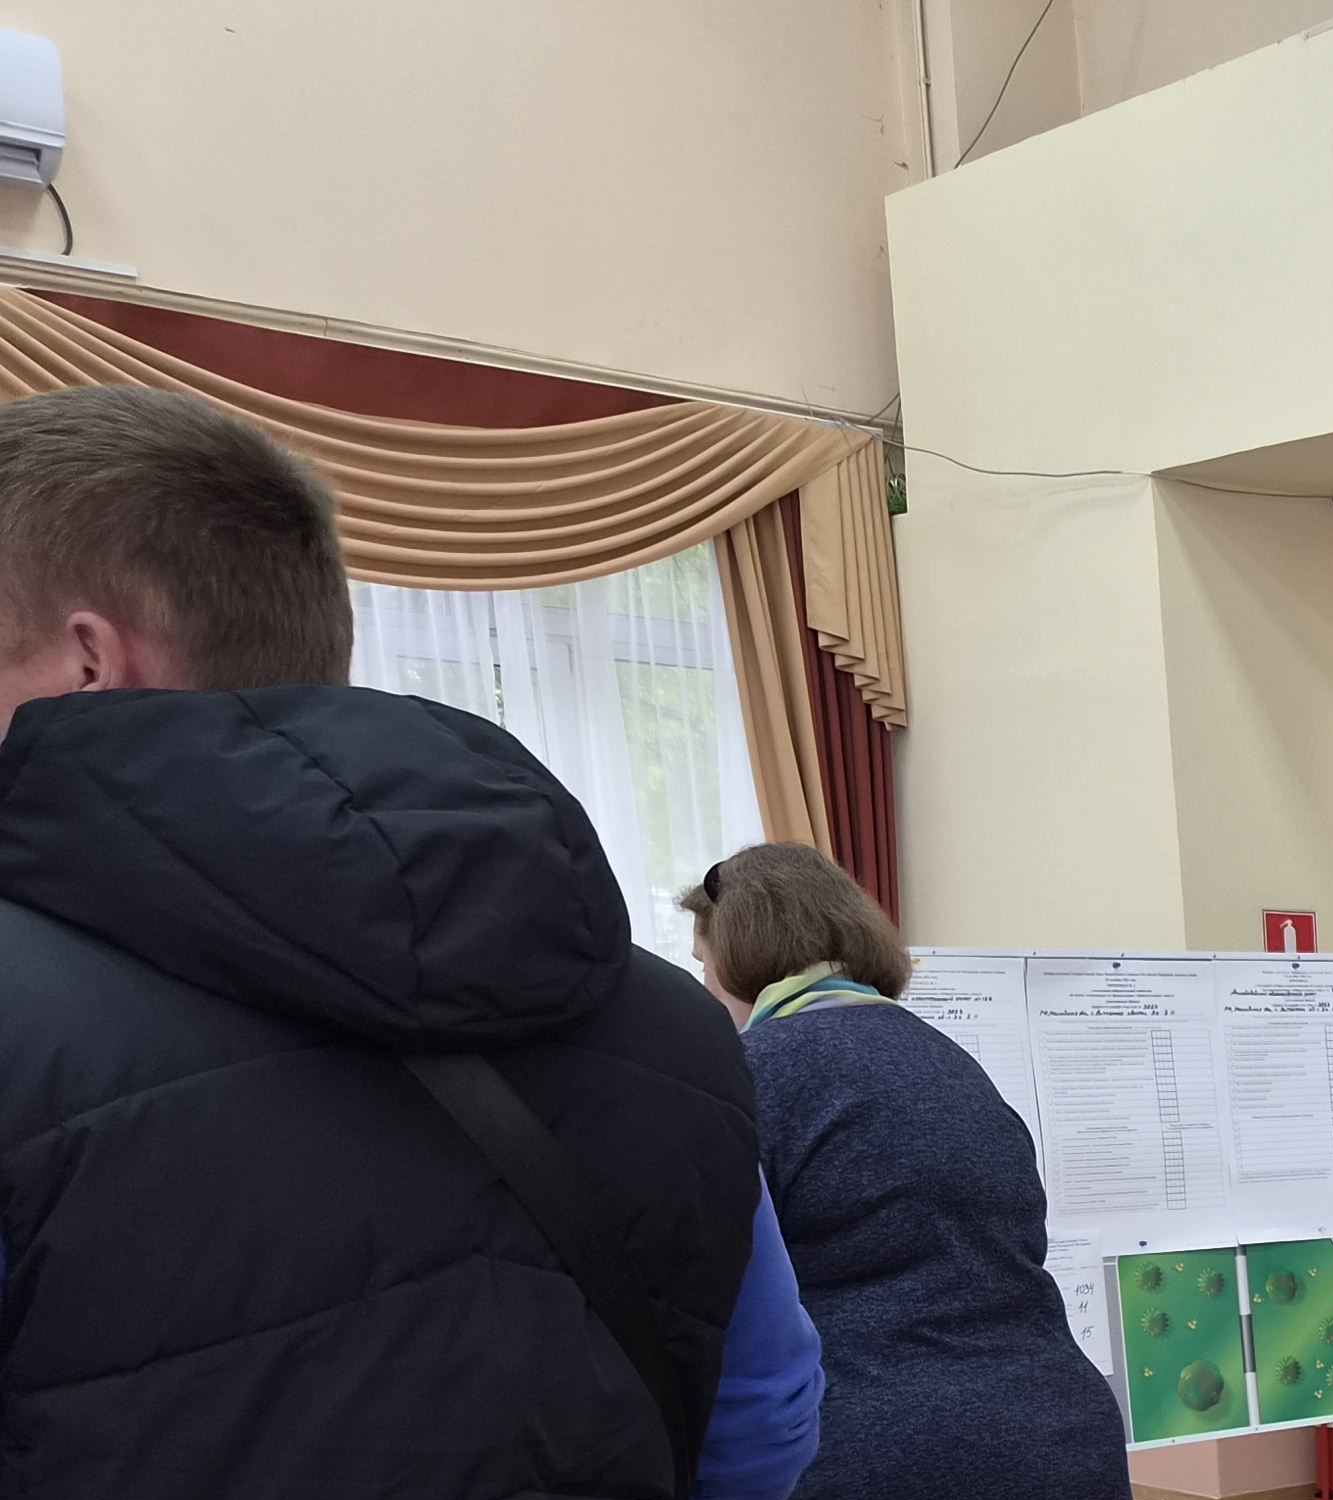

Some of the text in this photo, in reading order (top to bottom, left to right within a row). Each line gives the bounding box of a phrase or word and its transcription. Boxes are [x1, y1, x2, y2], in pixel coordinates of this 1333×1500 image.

[1075, 1283, 1095, 1296] 1034
[1079, 1301, 1089, 1313] 11
[1081, 1326, 1096, 1340] 15
